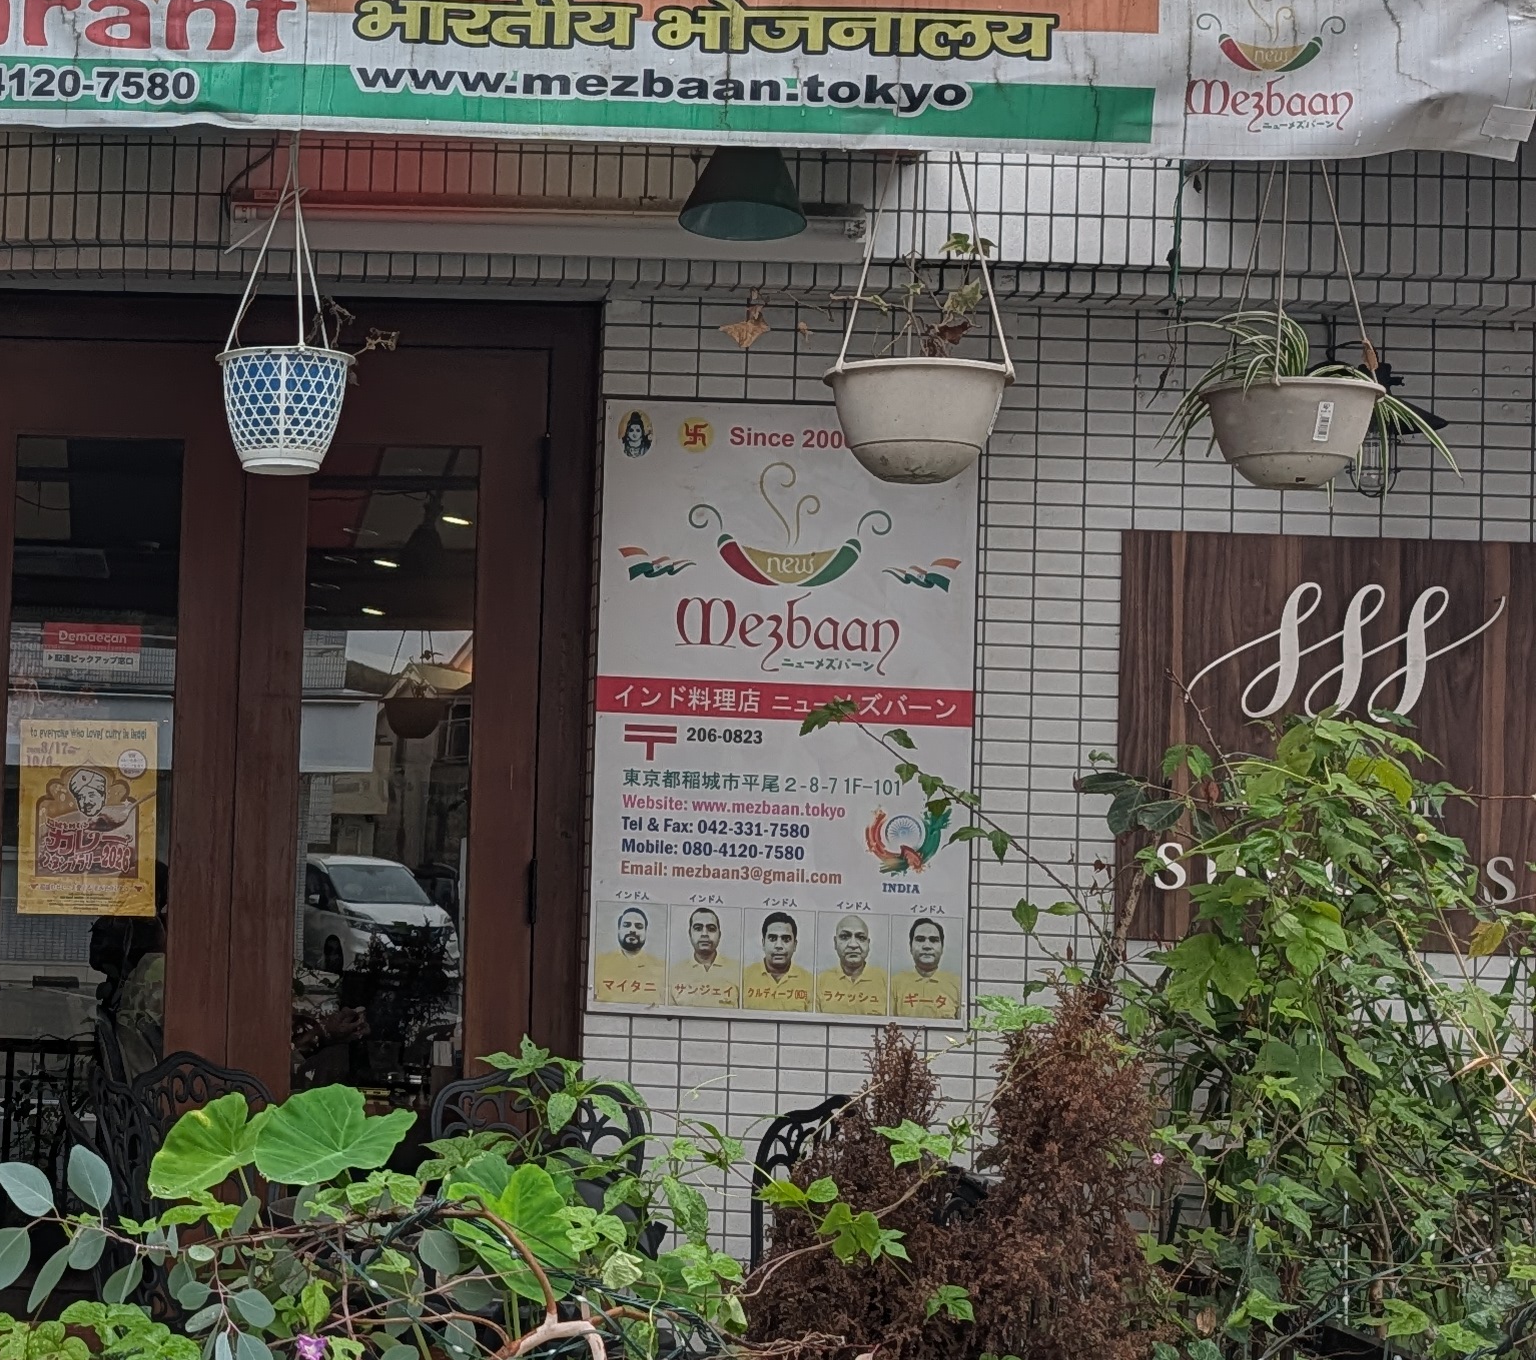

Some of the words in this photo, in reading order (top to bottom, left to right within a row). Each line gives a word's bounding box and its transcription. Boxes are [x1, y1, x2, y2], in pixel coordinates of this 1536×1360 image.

[361, 67, 967, 114] www.mezbaan.tokyo
[1185, 76, 1353, 132] Mezbaan
[730, 427, 794, 447] Since
[802, 430, 850, 450] 200
[767, 551, 814, 574] new
[58, 629, 127, 644] Demaecan
[675, 591, 900, 676] Mezbaan
[781, 657, 875, 671] ニューメズバーン
[614, 684, 761, 713] インド料理店
[686, 726, 763, 745] 206-0823
[622, 793, 689, 812] Website:
[692, 797, 846, 820] www.mezbaan.tokyo
[621, 815, 644, 831] Tel
[647, 817, 660, 832] &
[663, 818, 694, 834] Fax:
[697, 819, 810, 839] 042-331-7580
[621, 838, 679, 855] Mobile:
[681, 840, 805, 861] 080-4120-7580
[620, 860, 668, 877] Email:
[671, 863, 842, 885] mezbaan3@gmail.com
[615, 890, 650, 901] インド人
[881, 882, 921, 895] INDIA
[689, 893, 724, 905] インド人
[762, 896, 798, 909] インド人
[836, 899, 872, 912] インド人
[910, 903, 946, 915] インド人
[602, 979, 657, 993] マイタニ
[674, 982, 735, 998] サンジェイ
[822, 989, 880, 1004] ラケッシュ
[903, 992, 949, 1009] ギータ
